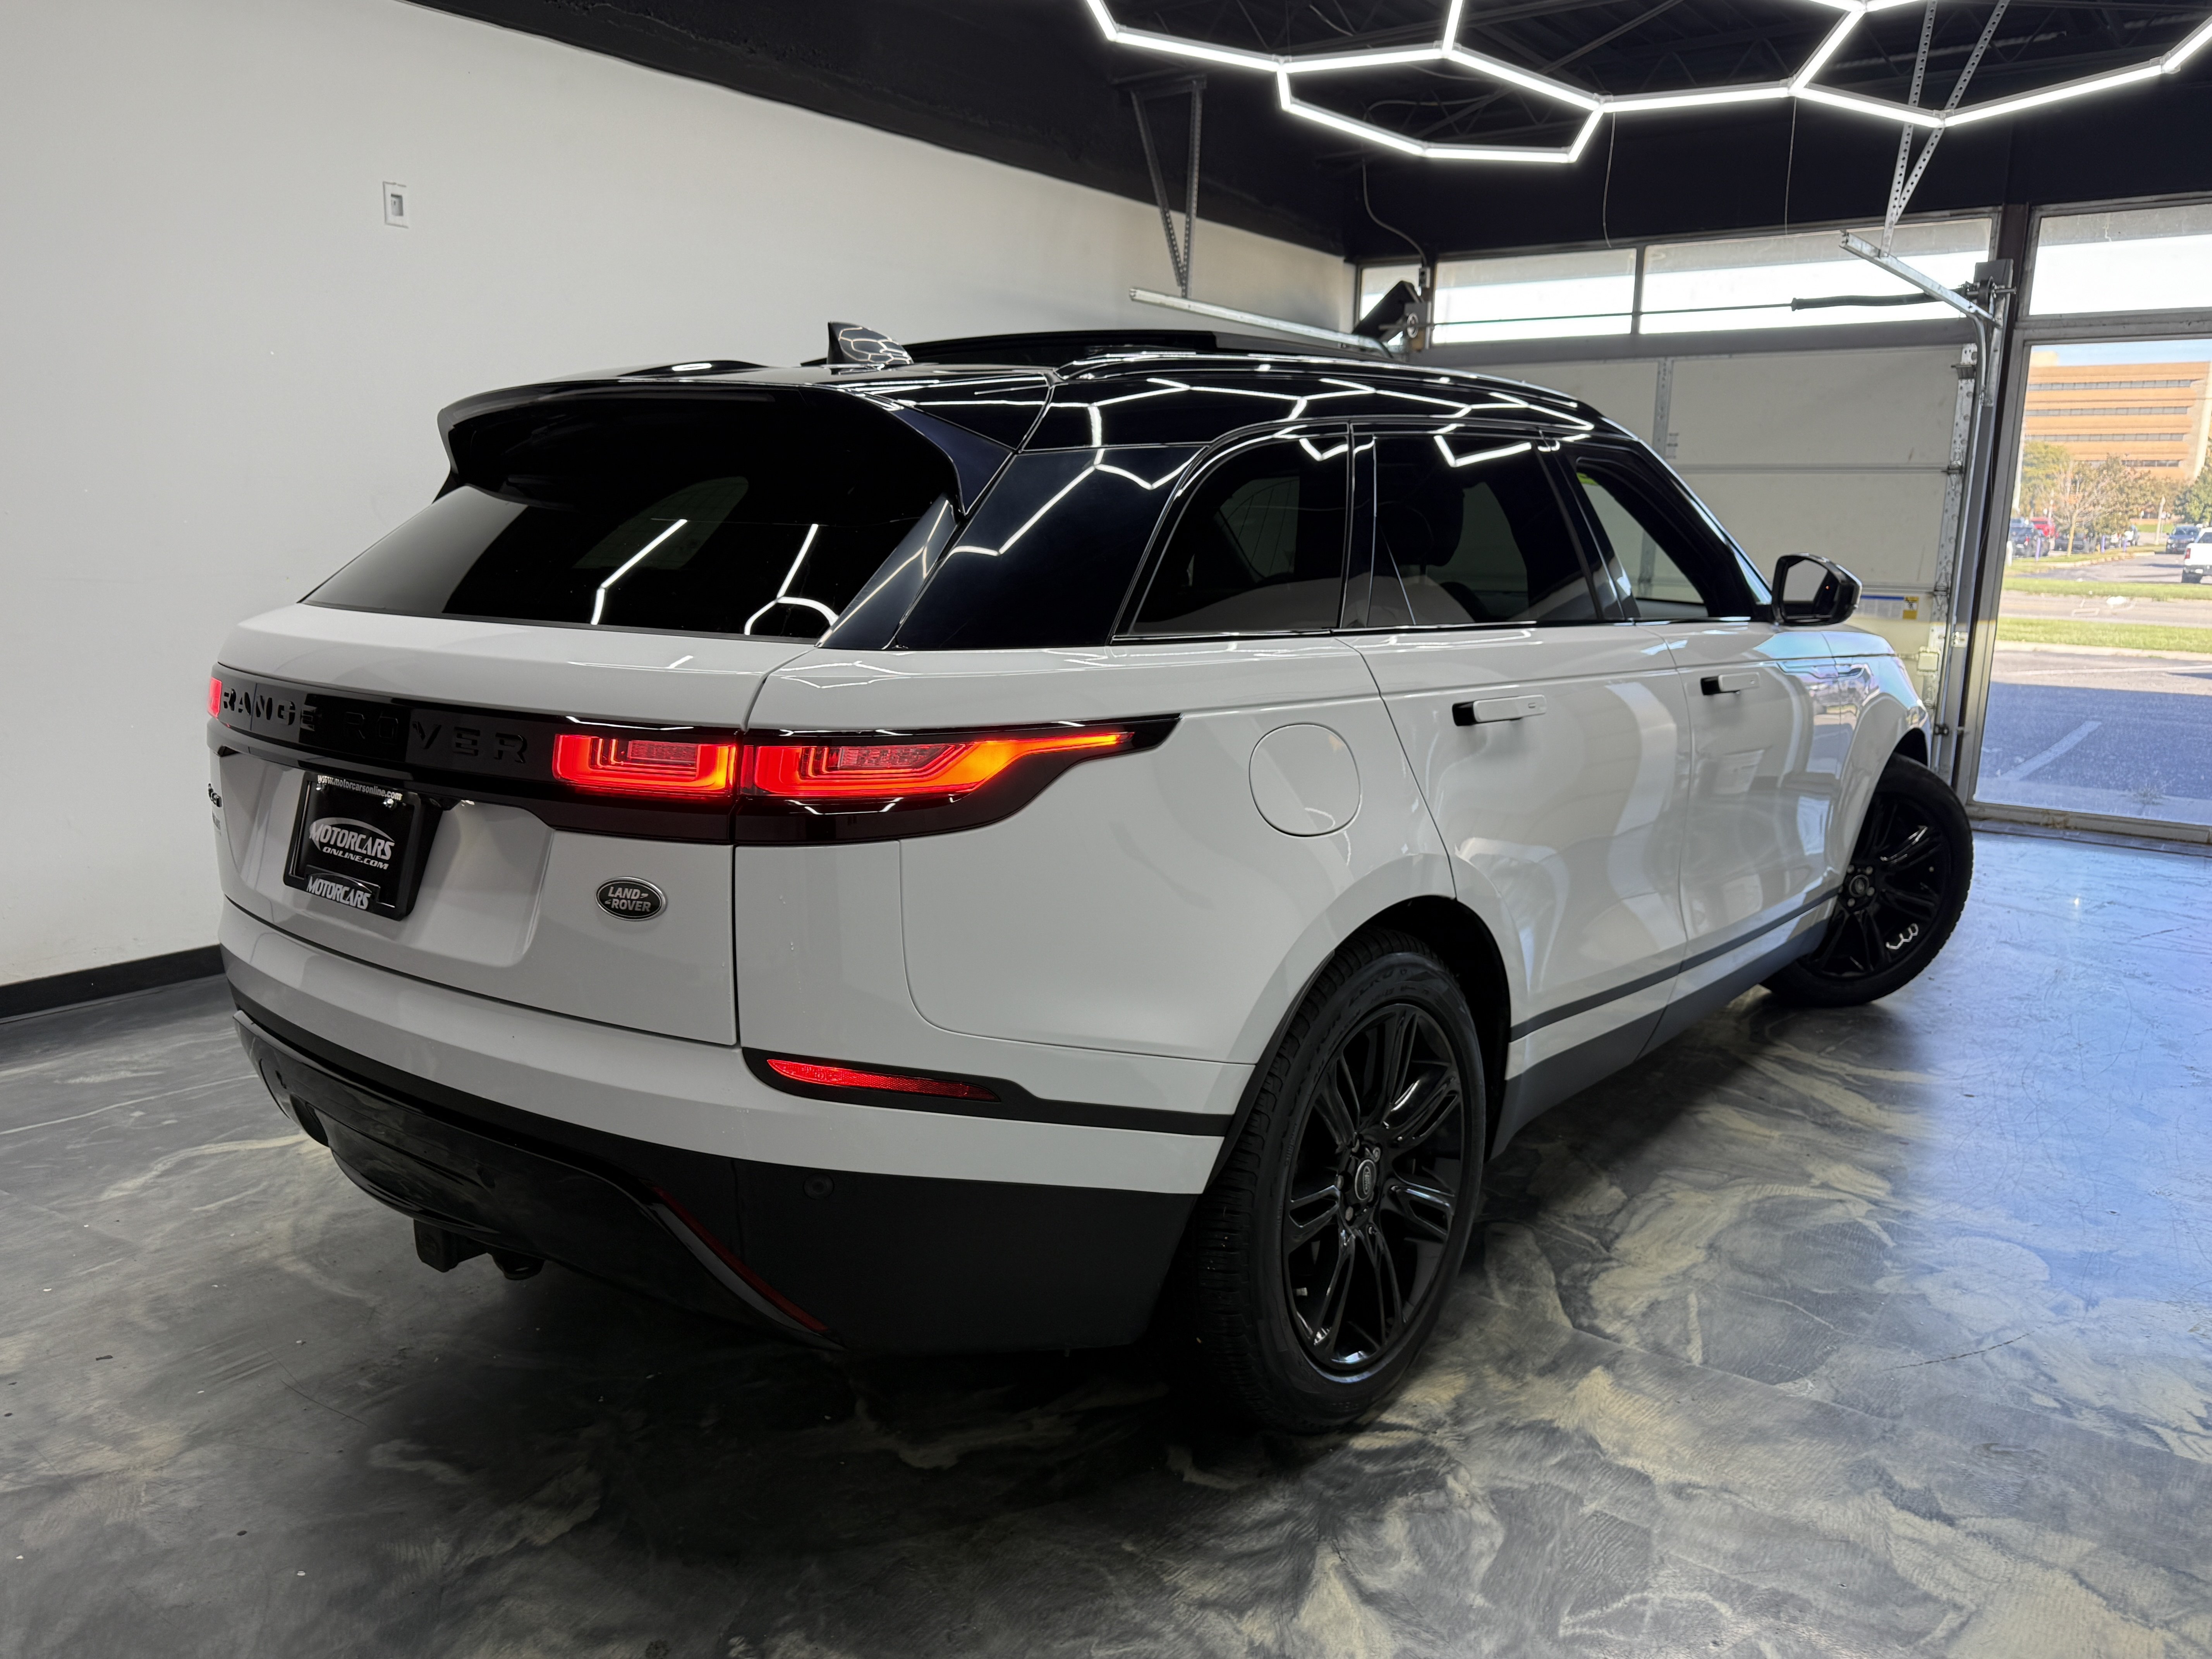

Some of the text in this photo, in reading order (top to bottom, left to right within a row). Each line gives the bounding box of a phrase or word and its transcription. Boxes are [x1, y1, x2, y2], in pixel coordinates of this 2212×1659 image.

[223, 687, 527, 764] RANGE ROVER
[318, 775, 402, 801] www.motorcarsonline.com
[309, 822, 395, 860] MOTORCARS
[322, 847, 389, 870] ONLINE.COM
[306, 876, 371, 910] MOTORCARS
[608, 886, 641, 900] LAND
[611, 898, 651, 912] ROVER
